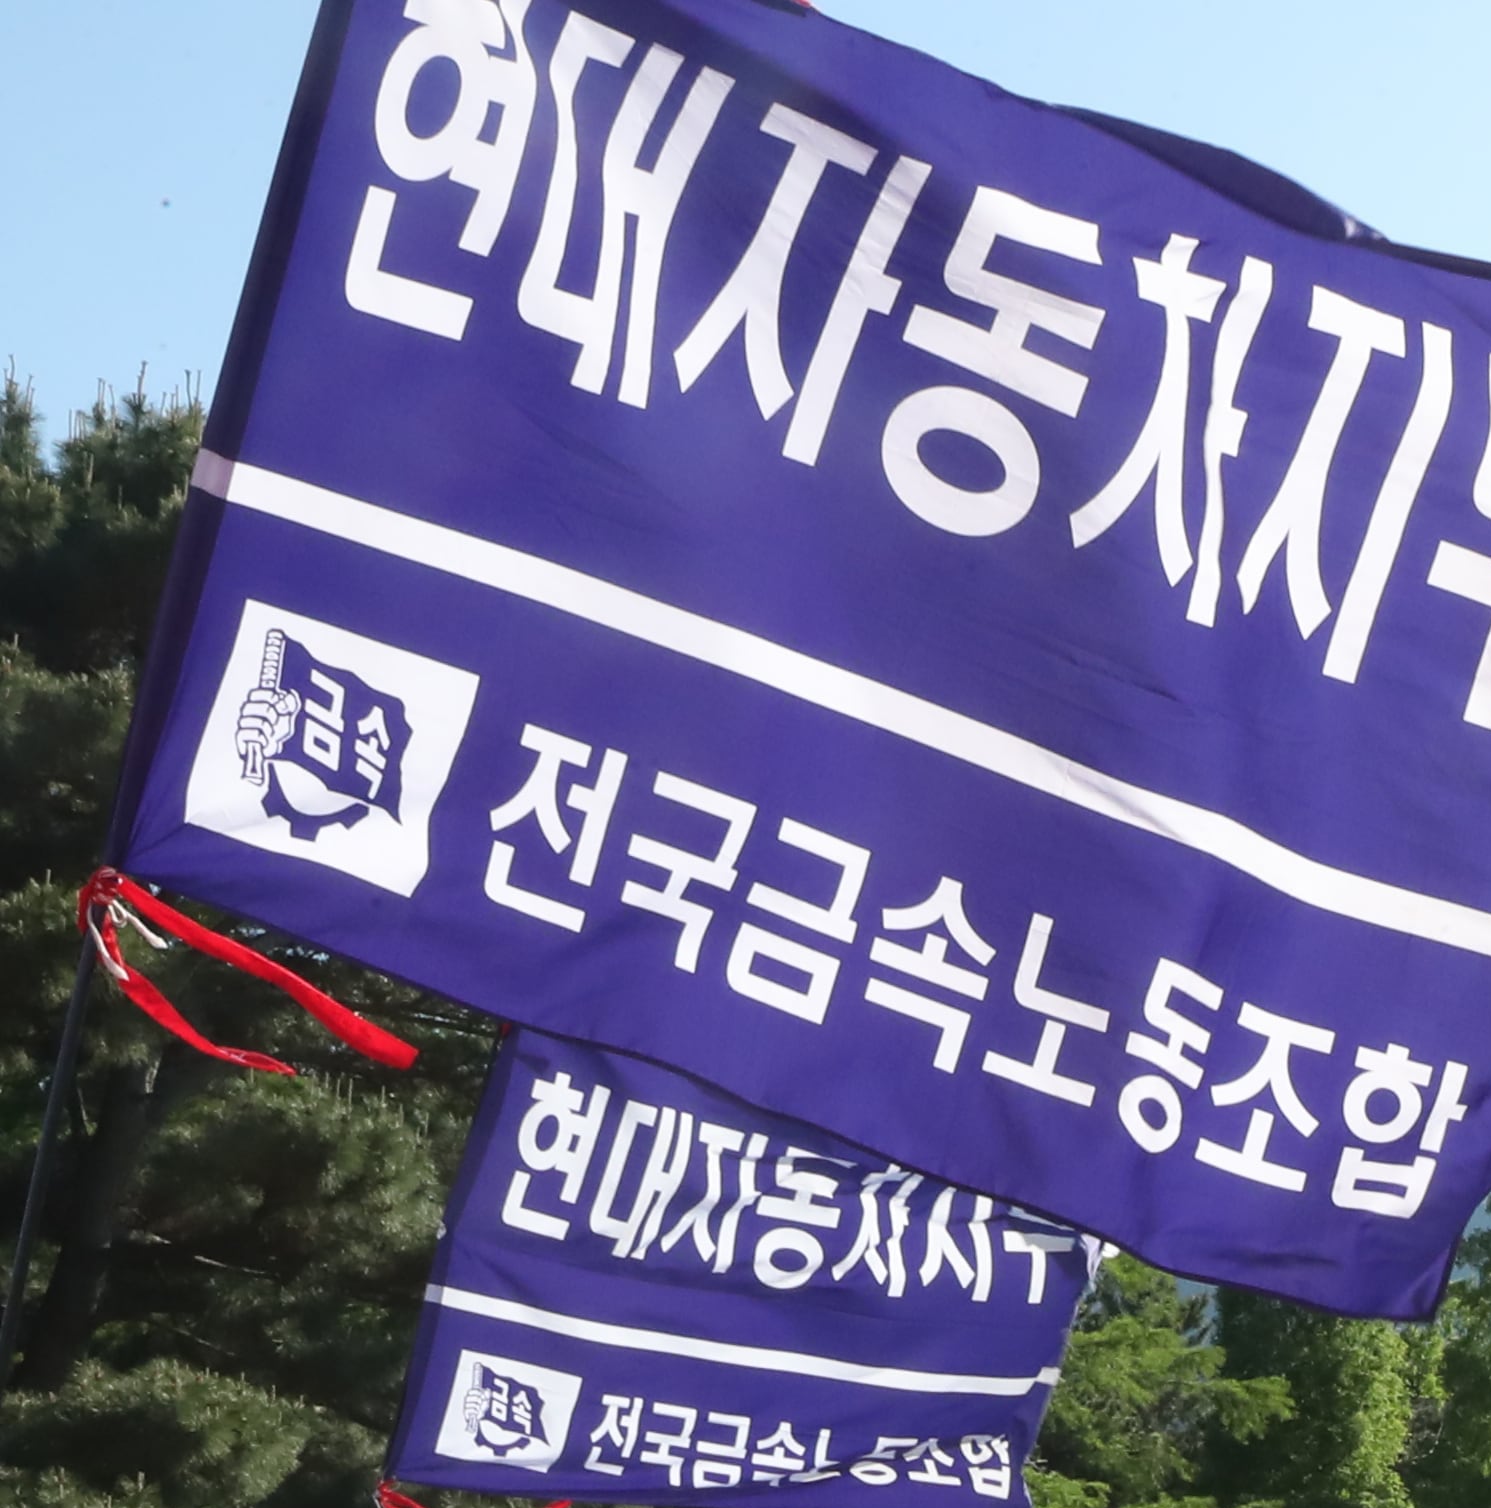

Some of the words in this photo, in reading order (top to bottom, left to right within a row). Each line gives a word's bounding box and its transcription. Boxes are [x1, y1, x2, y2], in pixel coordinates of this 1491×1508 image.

[303, 669, 391, 800] 금속
[484, 720, 1469, 1219] 전국금속노동조합
[491, 1378, 532, 1435] 금속
